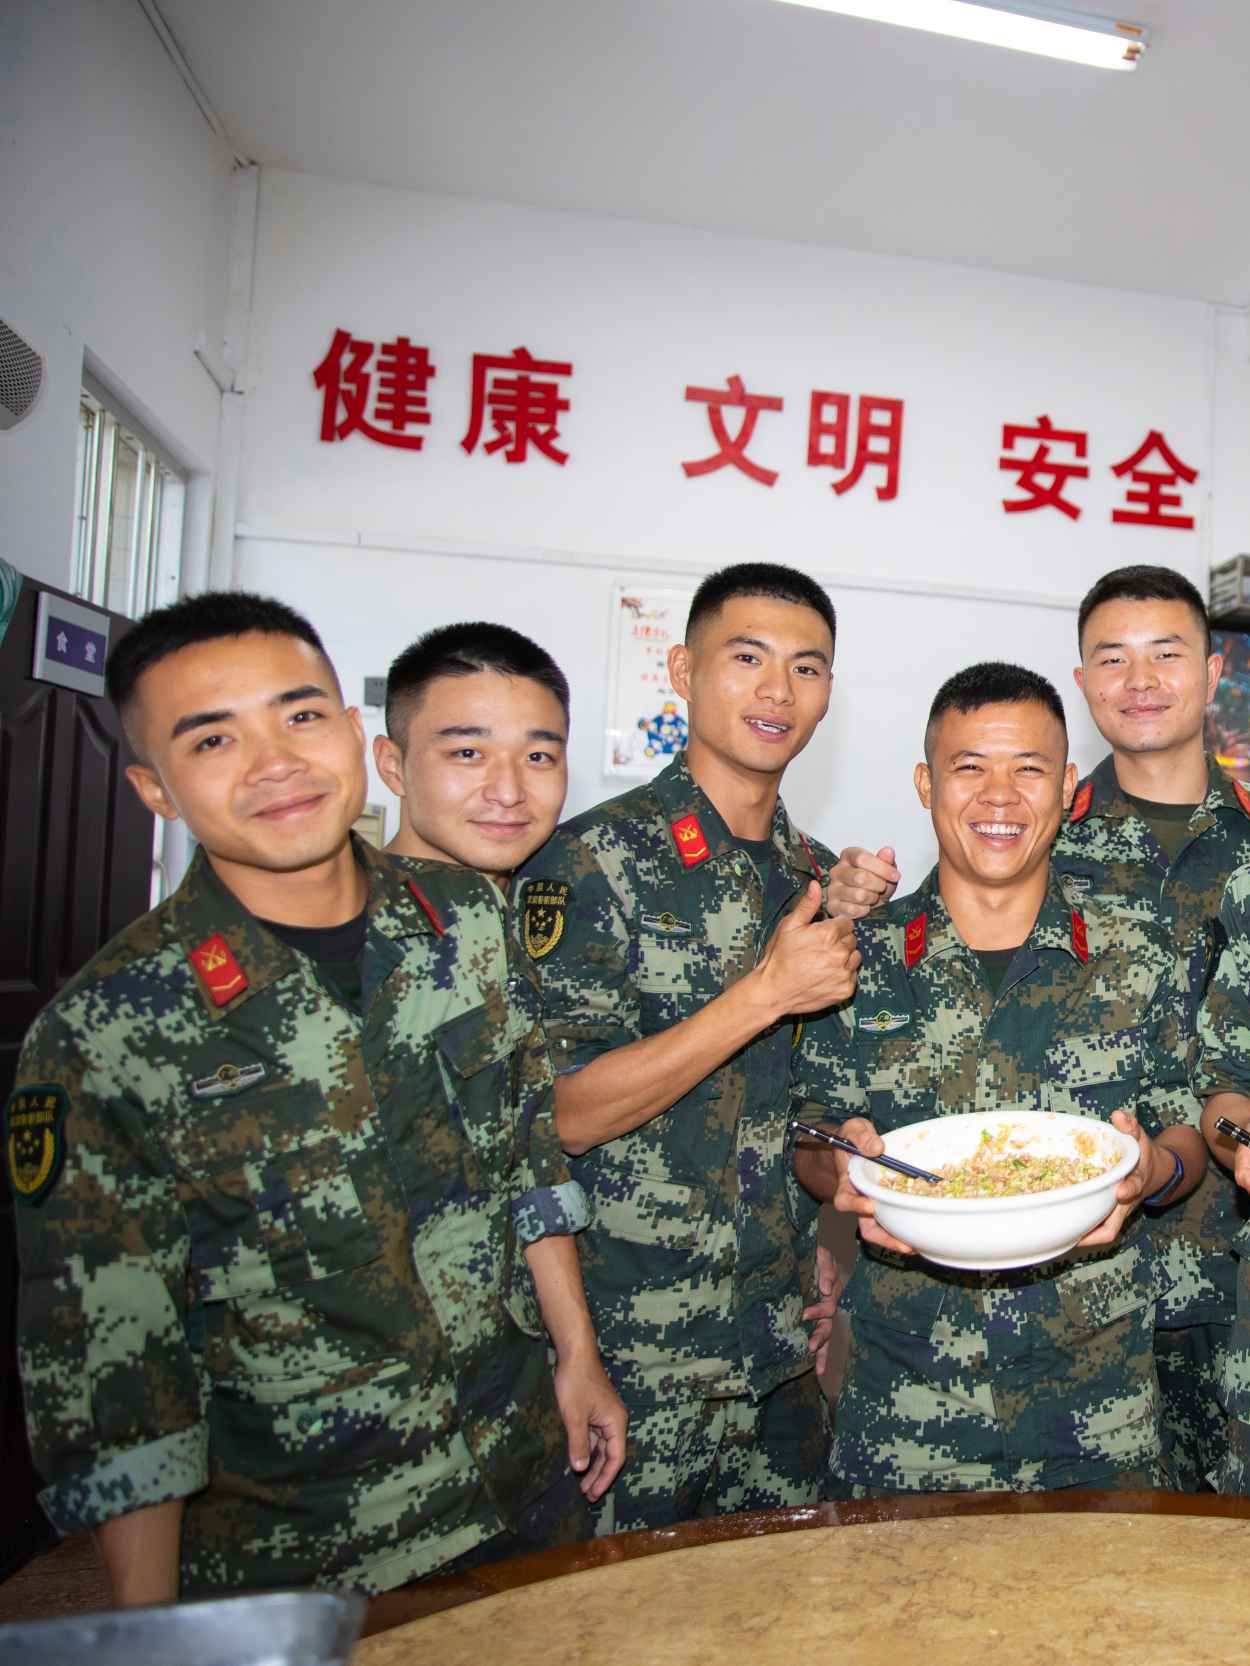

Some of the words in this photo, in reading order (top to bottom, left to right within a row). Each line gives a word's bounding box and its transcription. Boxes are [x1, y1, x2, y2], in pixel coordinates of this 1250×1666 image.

[314, 330, 572, 465] 健康
[683, 377, 903, 500] 文明
[1000, 416, 1197, 529] 安全
